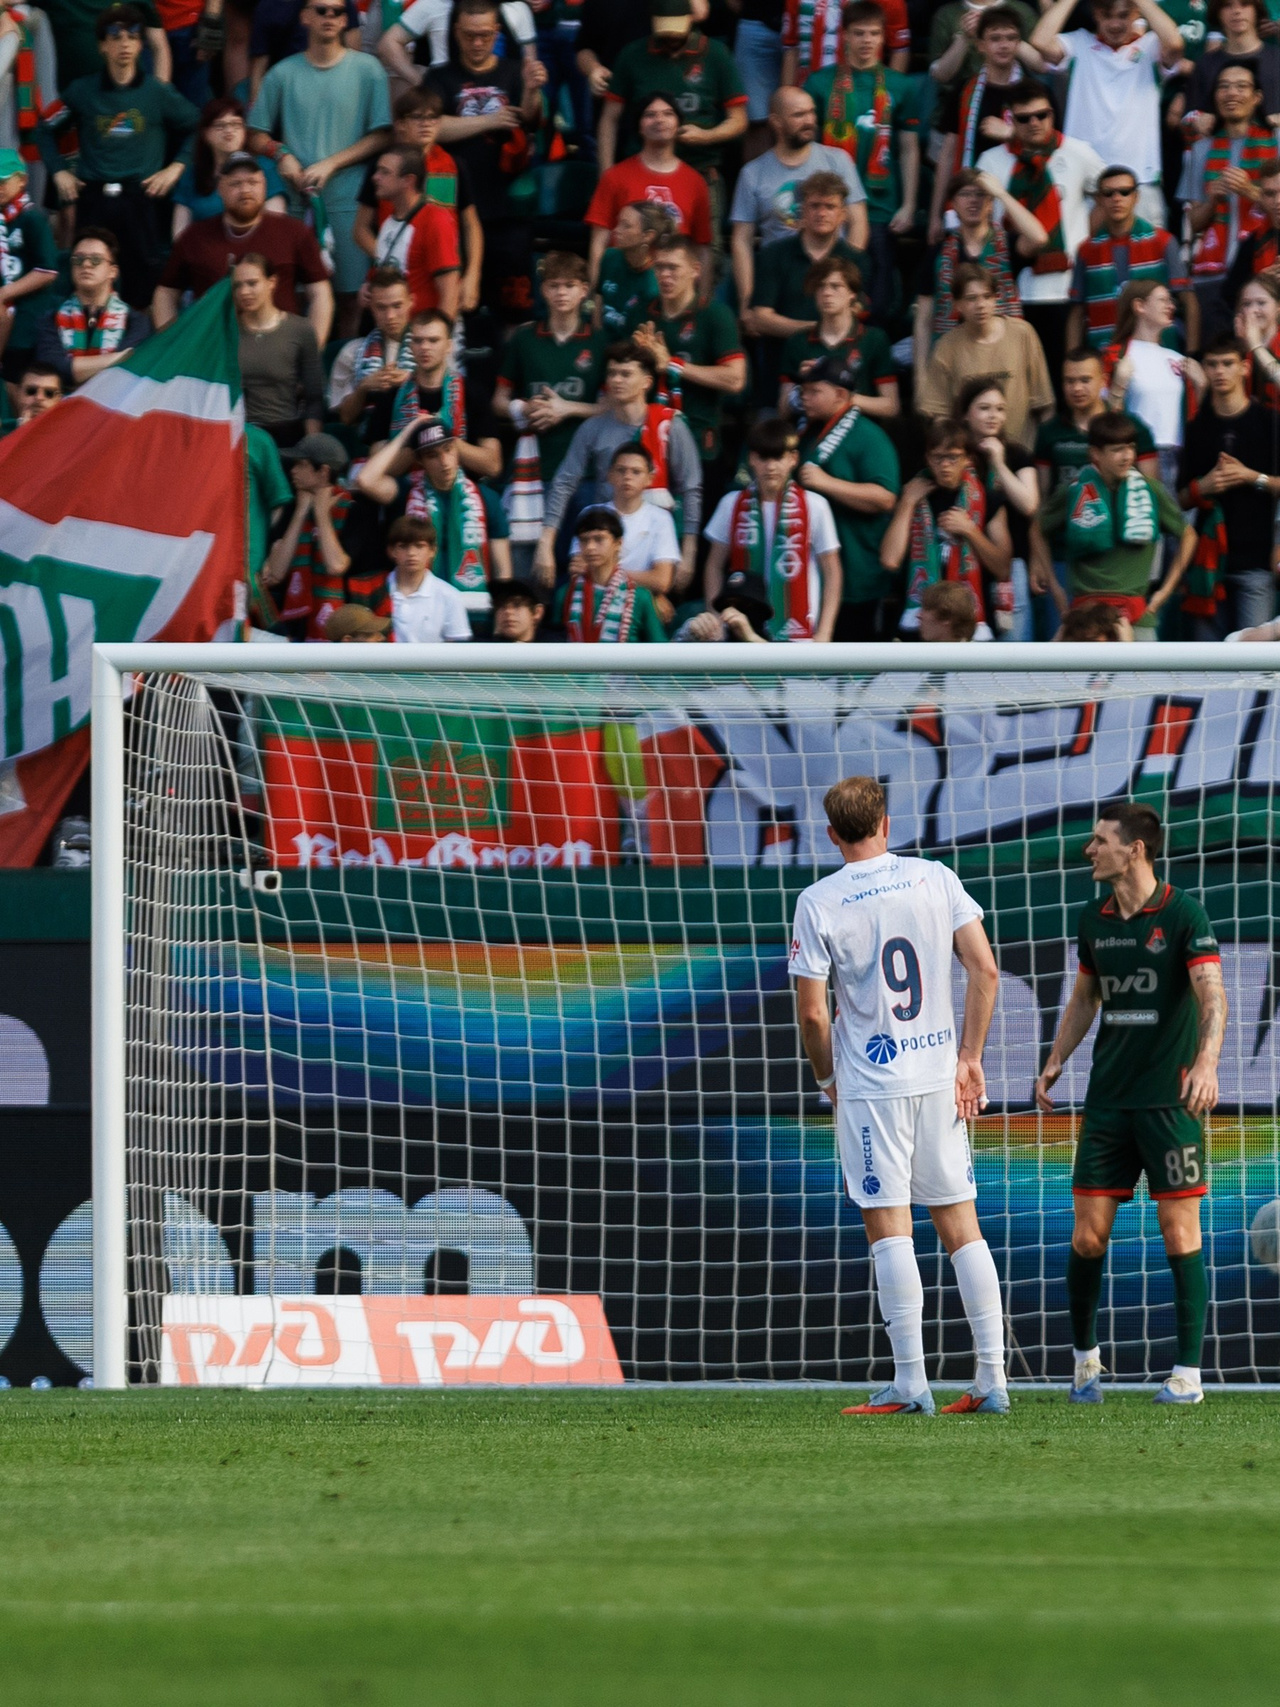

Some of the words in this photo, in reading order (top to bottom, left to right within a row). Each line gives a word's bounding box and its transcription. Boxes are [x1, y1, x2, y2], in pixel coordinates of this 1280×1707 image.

[841, 879, 912, 906] АЭРОФЛОТ
[881, 936, 923, 1022] 9
[861, 1126, 874, 1172] РОССЕТИ
[1165, 1146, 1200, 1186] 85
